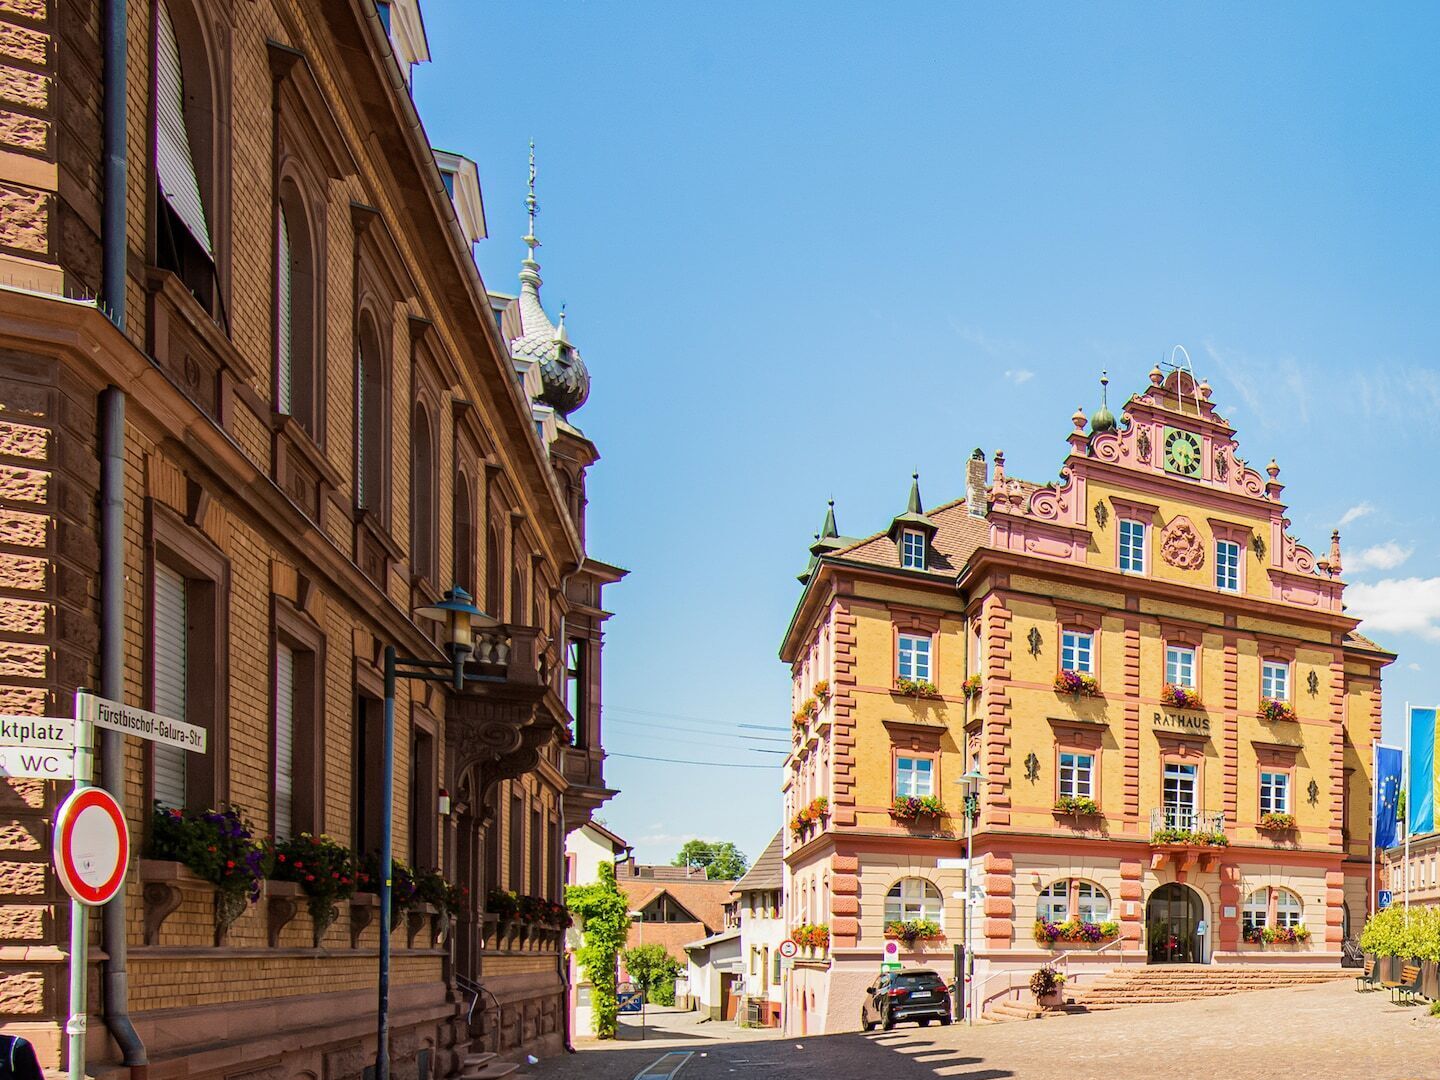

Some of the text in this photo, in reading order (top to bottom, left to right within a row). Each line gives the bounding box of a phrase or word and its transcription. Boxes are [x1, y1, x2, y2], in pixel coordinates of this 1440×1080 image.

[98, 703, 203, 748] Fürstbischof-Galura-Str.
[1153, 712, 1211, 729] RATHAUS
[20, 754, 60, 773] WC
